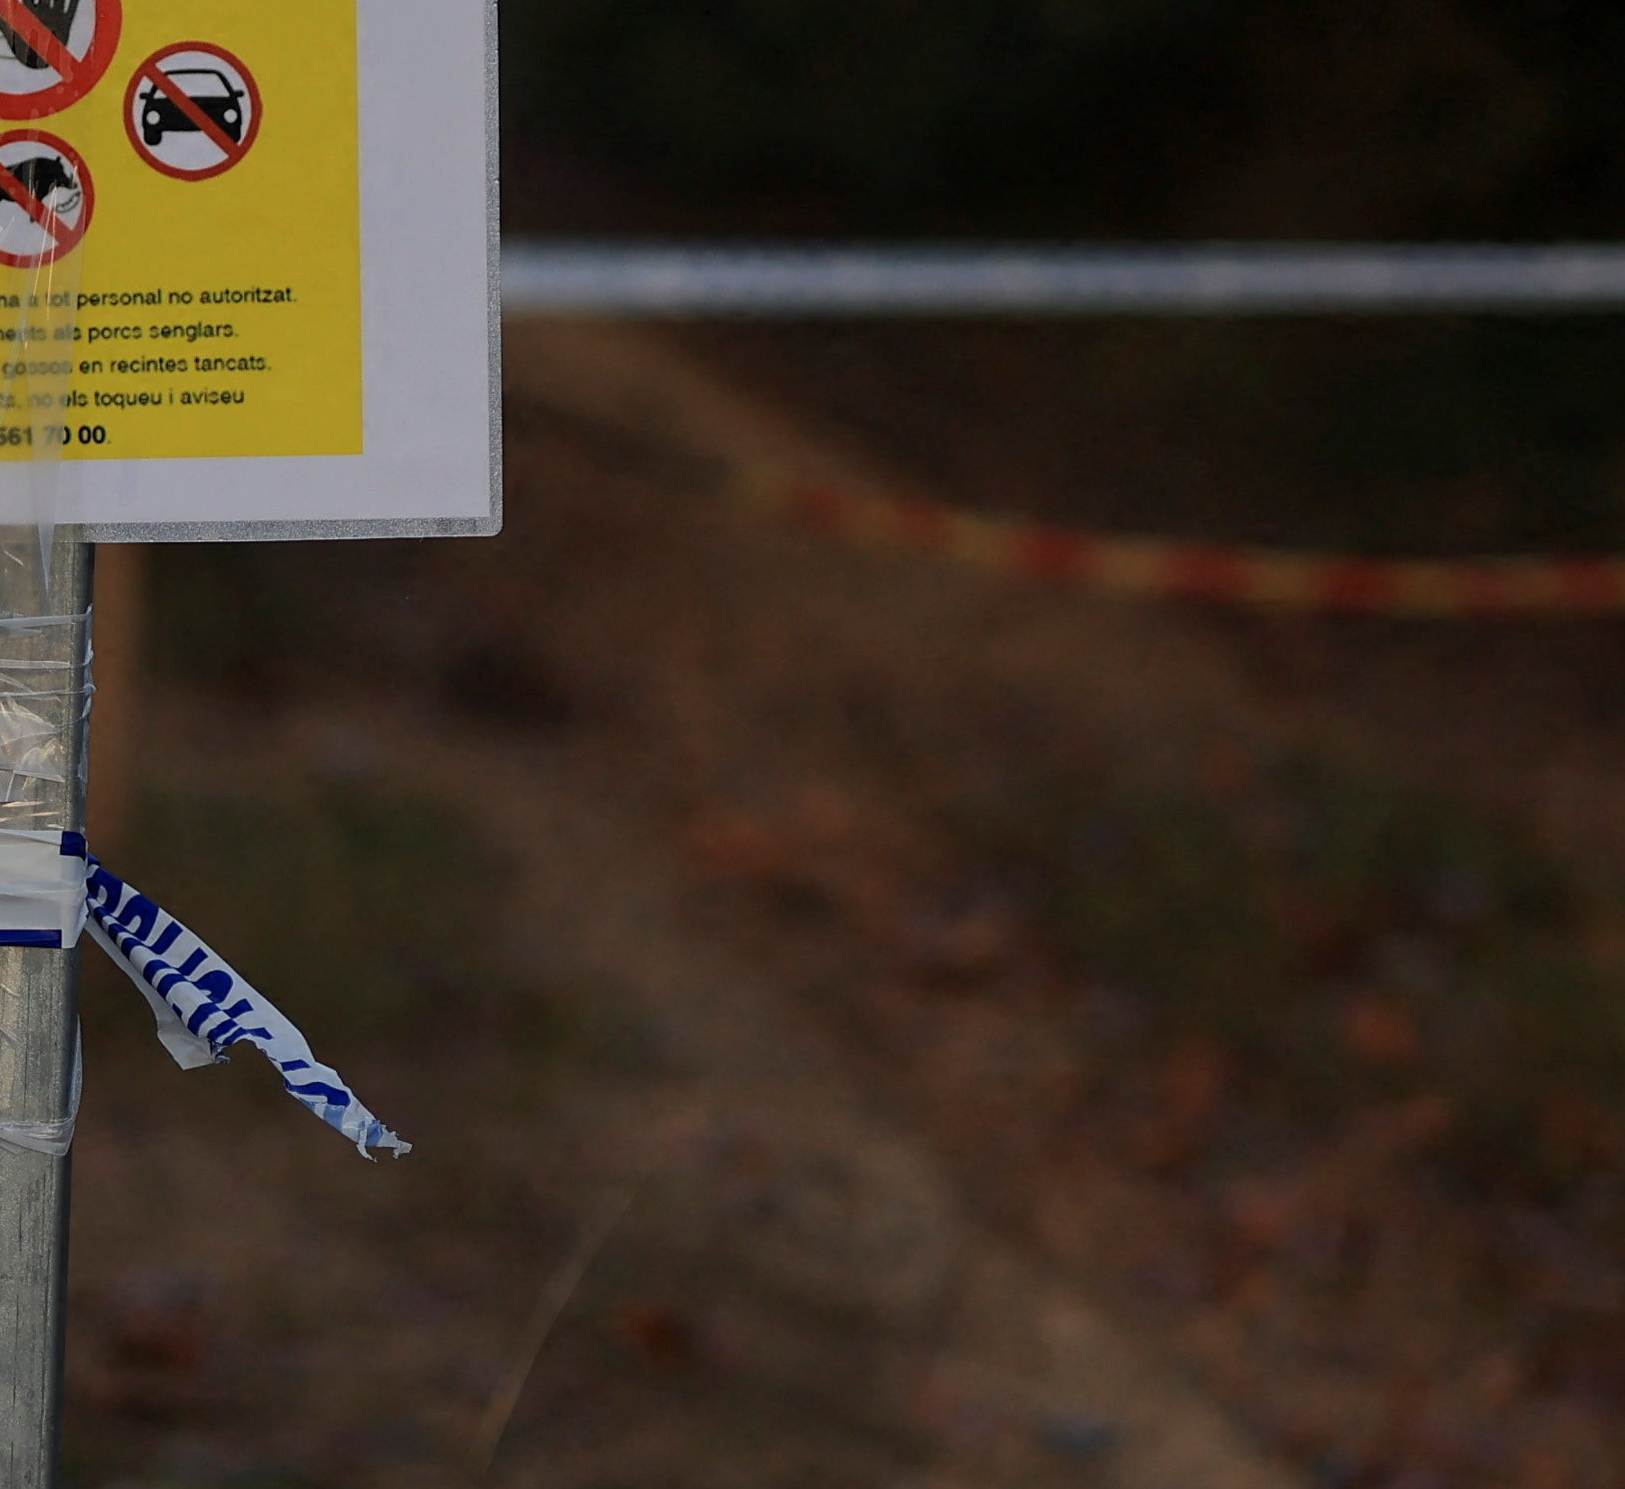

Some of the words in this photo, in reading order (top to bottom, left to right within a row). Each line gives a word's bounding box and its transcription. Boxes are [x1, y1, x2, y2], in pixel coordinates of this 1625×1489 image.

[29, 294, 39, 307] a
[77, 289, 162, 310] personal
[167, 290, 193, 304] no
[54, 324, 82, 341] als
[88, 324, 142, 344] porcs
[149, 322, 239, 343] senglars.
[79, 360, 103, 373] en
[110, 356, 188, 373] recintes
[29, 393, 53, 407] no
[62, 391, 88, 407] els
[94, 389, 162, 410] toqueu
[169, 389, 173, 405] i
[180, 388, 245, 405] aviseu
